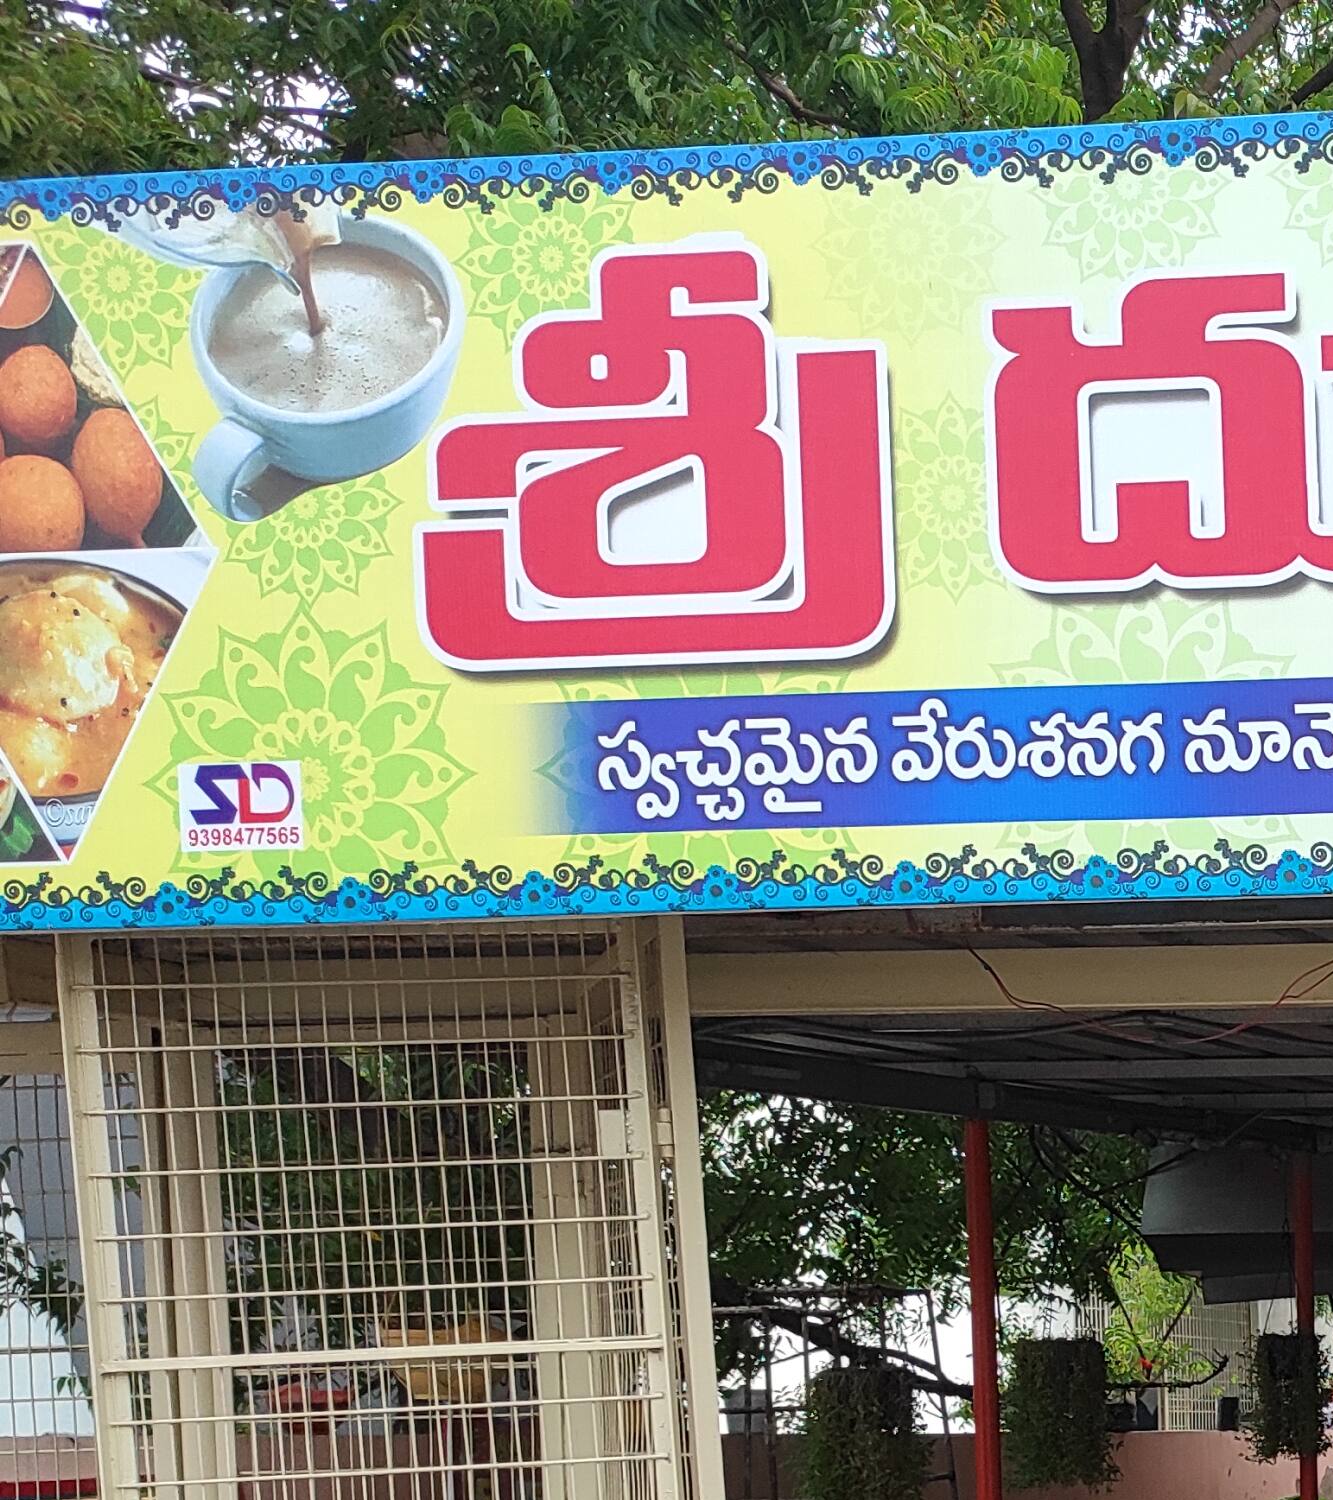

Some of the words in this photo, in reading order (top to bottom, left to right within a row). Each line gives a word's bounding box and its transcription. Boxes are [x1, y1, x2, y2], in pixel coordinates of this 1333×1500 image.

[422, 250, 886, 662] శ్రీ
[890, 699, 1165, 783] వేరుశనగ
[188, 826, 300, 847] 9398477565
